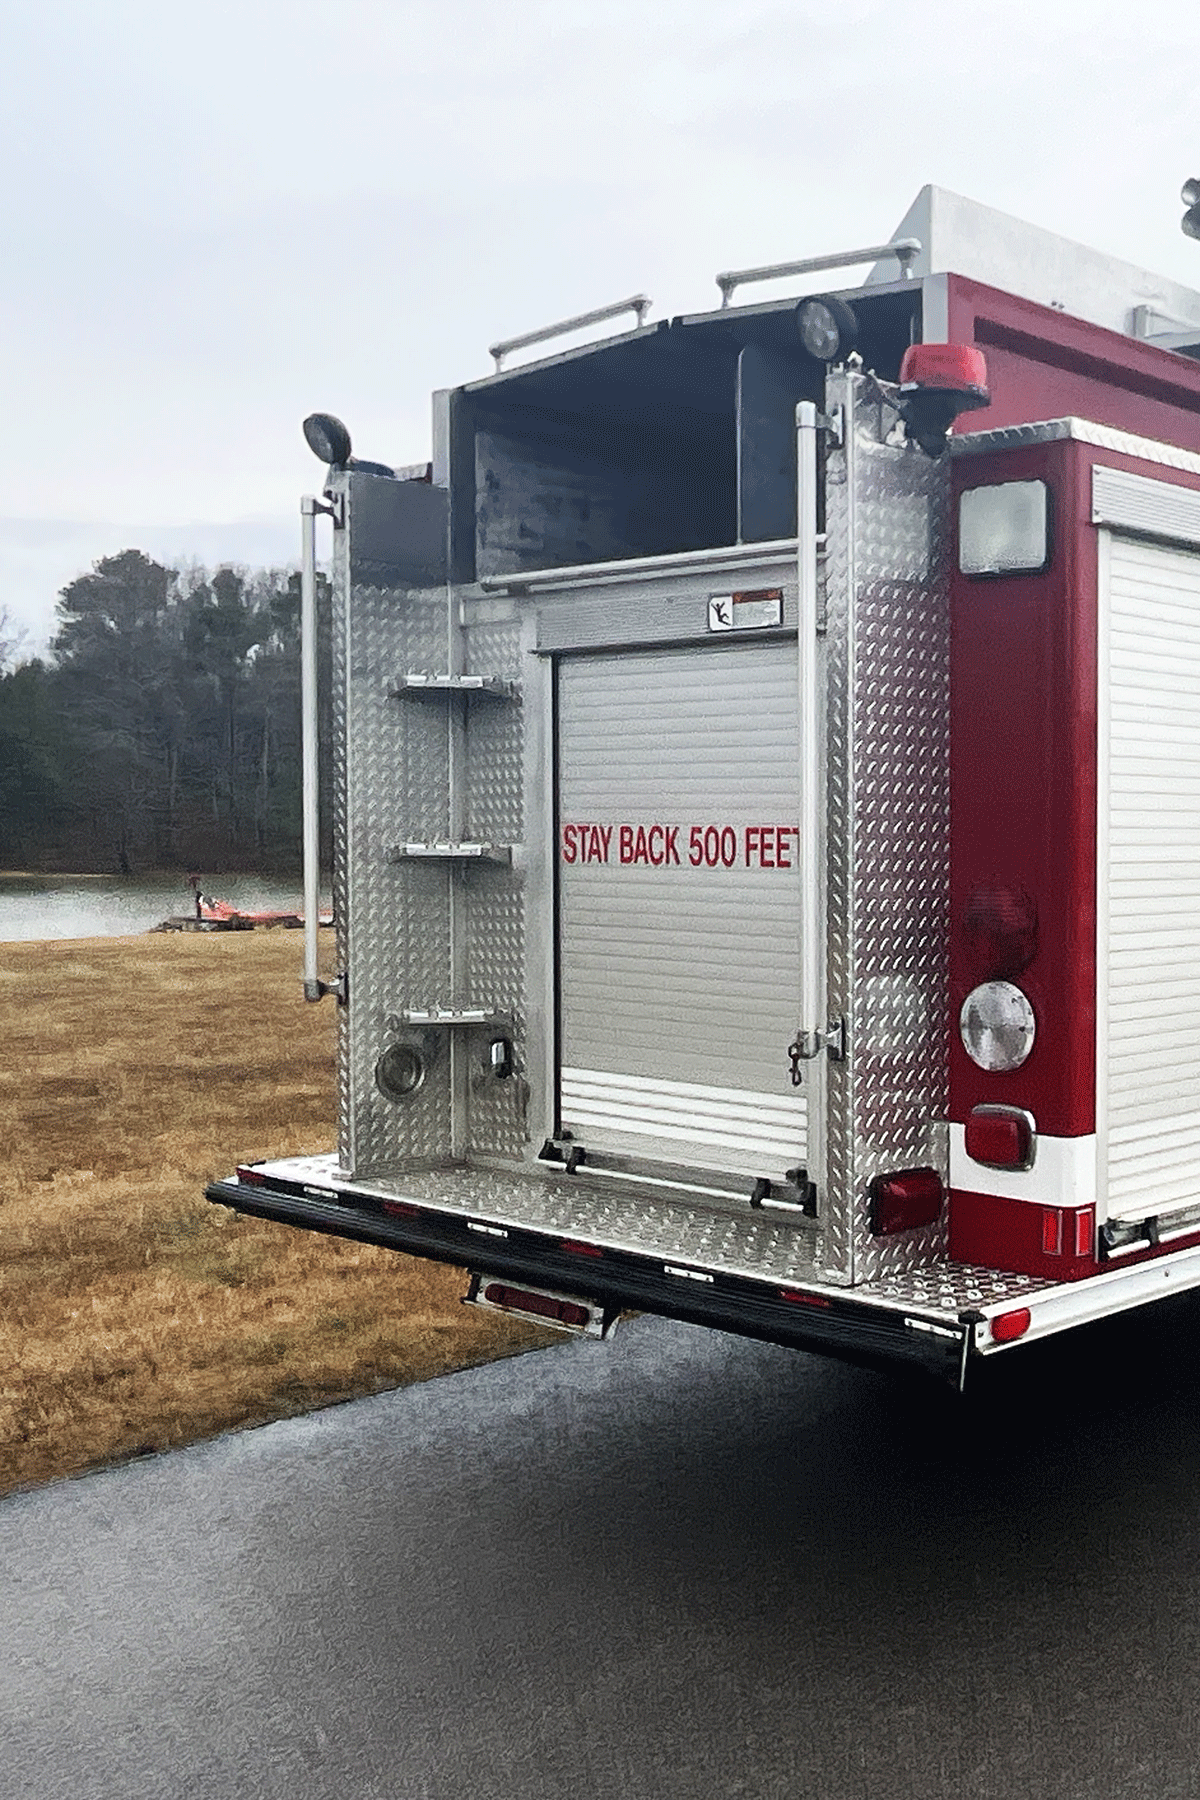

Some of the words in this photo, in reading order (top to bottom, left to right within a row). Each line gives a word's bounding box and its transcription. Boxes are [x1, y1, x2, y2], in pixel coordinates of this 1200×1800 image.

[563, 824, 613, 864] STAY
[619, 825, 681, 866] BACK
[688, 825, 737, 868] 500
